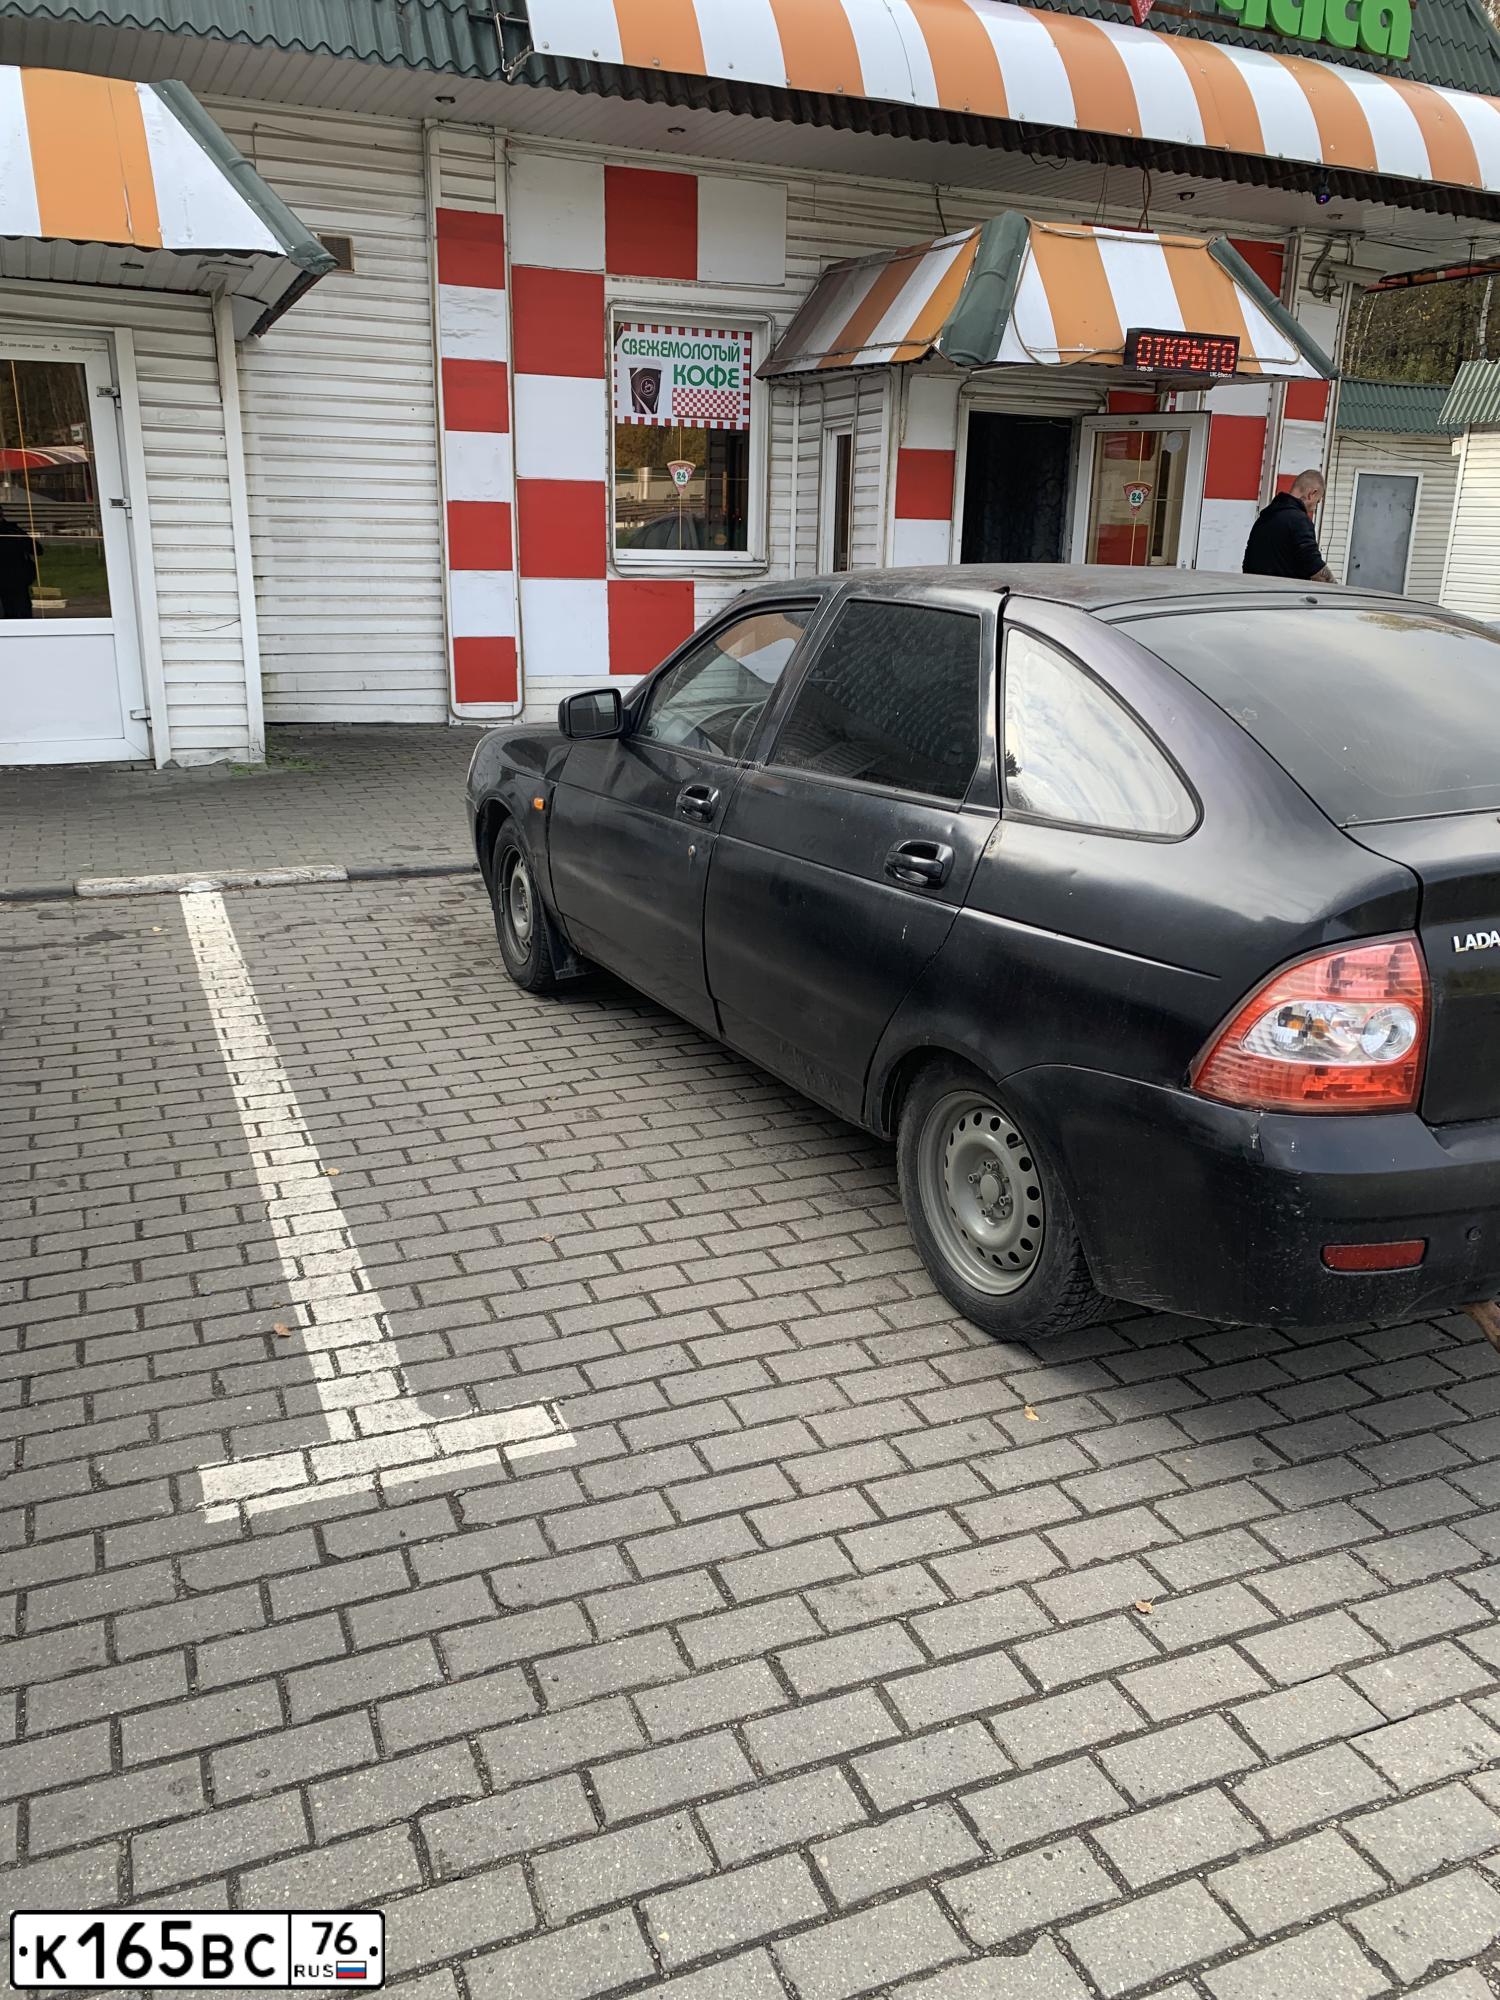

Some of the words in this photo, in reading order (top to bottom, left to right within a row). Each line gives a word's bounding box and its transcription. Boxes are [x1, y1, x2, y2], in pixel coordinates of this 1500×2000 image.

[621, 338, 740, 363] СВЕЖЕМОЛОТЫЙ
[1137, 336, 1236, 372] ОТКРЫТО
[673, 364, 740, 389] КОФЕ
[676, 471, 687, 480] 24
[1131, 492, 1142, 501] 24
[1452, 930, 1500, 953] LADA
